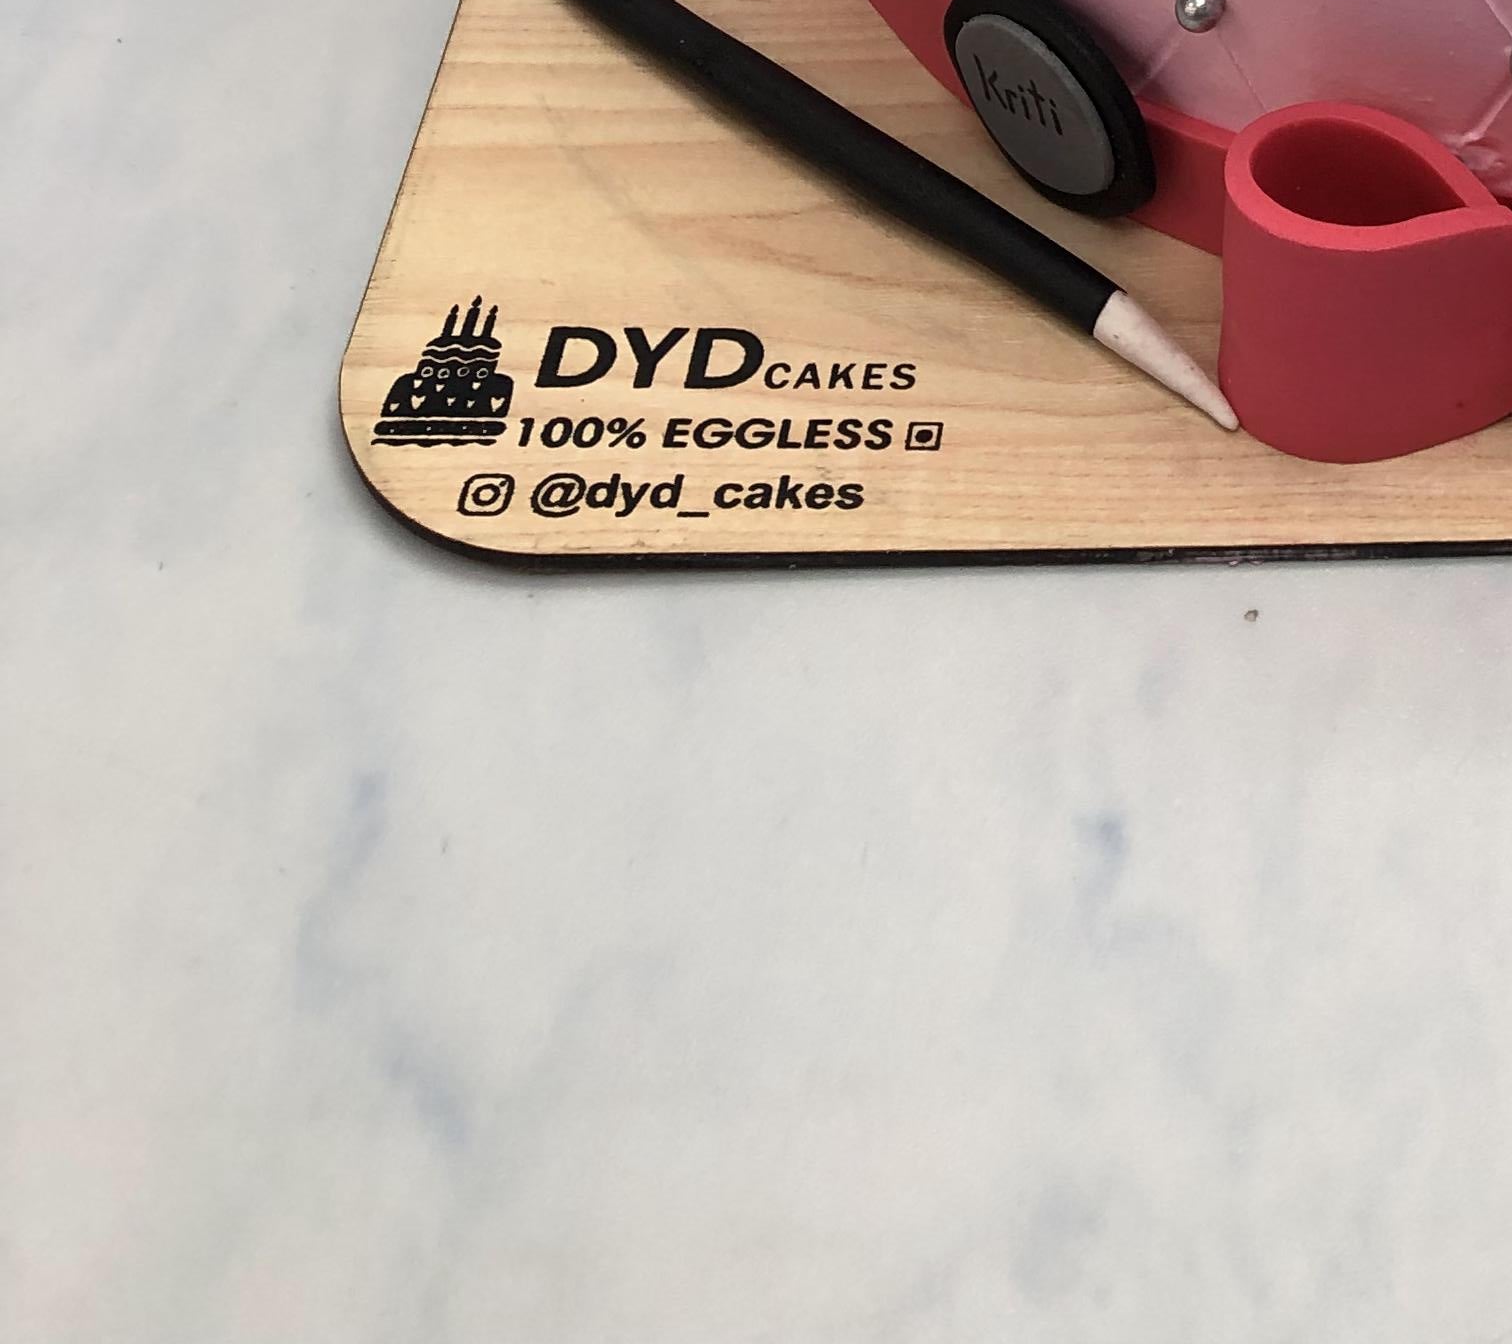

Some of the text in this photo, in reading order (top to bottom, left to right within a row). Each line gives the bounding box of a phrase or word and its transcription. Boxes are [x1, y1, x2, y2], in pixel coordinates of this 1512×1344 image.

[973, 54, 1065, 136] Kriti
[535, 325, 917, 392] DYD CAKES
[516, 417, 893, 452] 100% EGGLESS
[530, 472, 865, 519] @dyd_cakes
